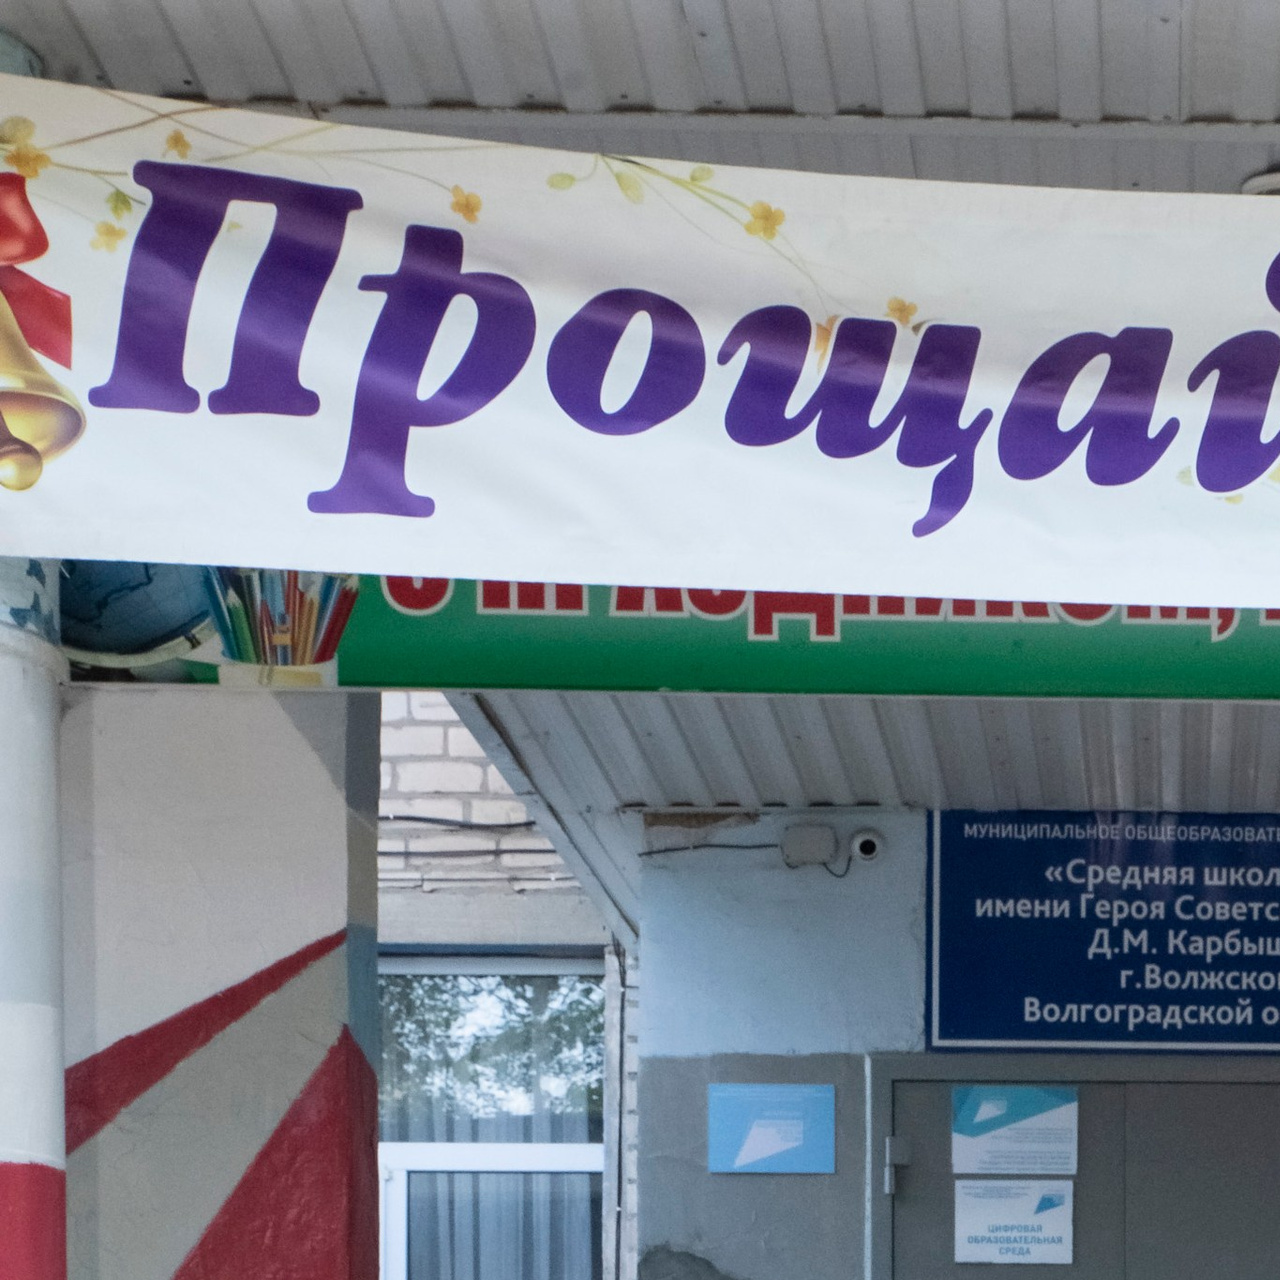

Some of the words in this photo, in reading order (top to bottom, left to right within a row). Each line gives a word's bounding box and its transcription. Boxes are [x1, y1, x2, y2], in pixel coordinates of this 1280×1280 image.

[963, 823, 1121, 841] МУНИЦИПАЛЬНОЕ
[1044, 858, 1195, 891] «Средняя
[975, 898, 1070, 918] имени
[1079, 893, 1165, 927] Героя
[1087, 928, 1157, 960] Д.М.
[1023, 997, 1254, 1031] Волгоградской
[967, 1235, 1063, 1246] ОБРАЗОВАТЕЛЬНАЯ
[988, 1223, 1043, 1234] ЦИФРОВАЯ
[998, 1246, 1032, 1256] СРЕДА
